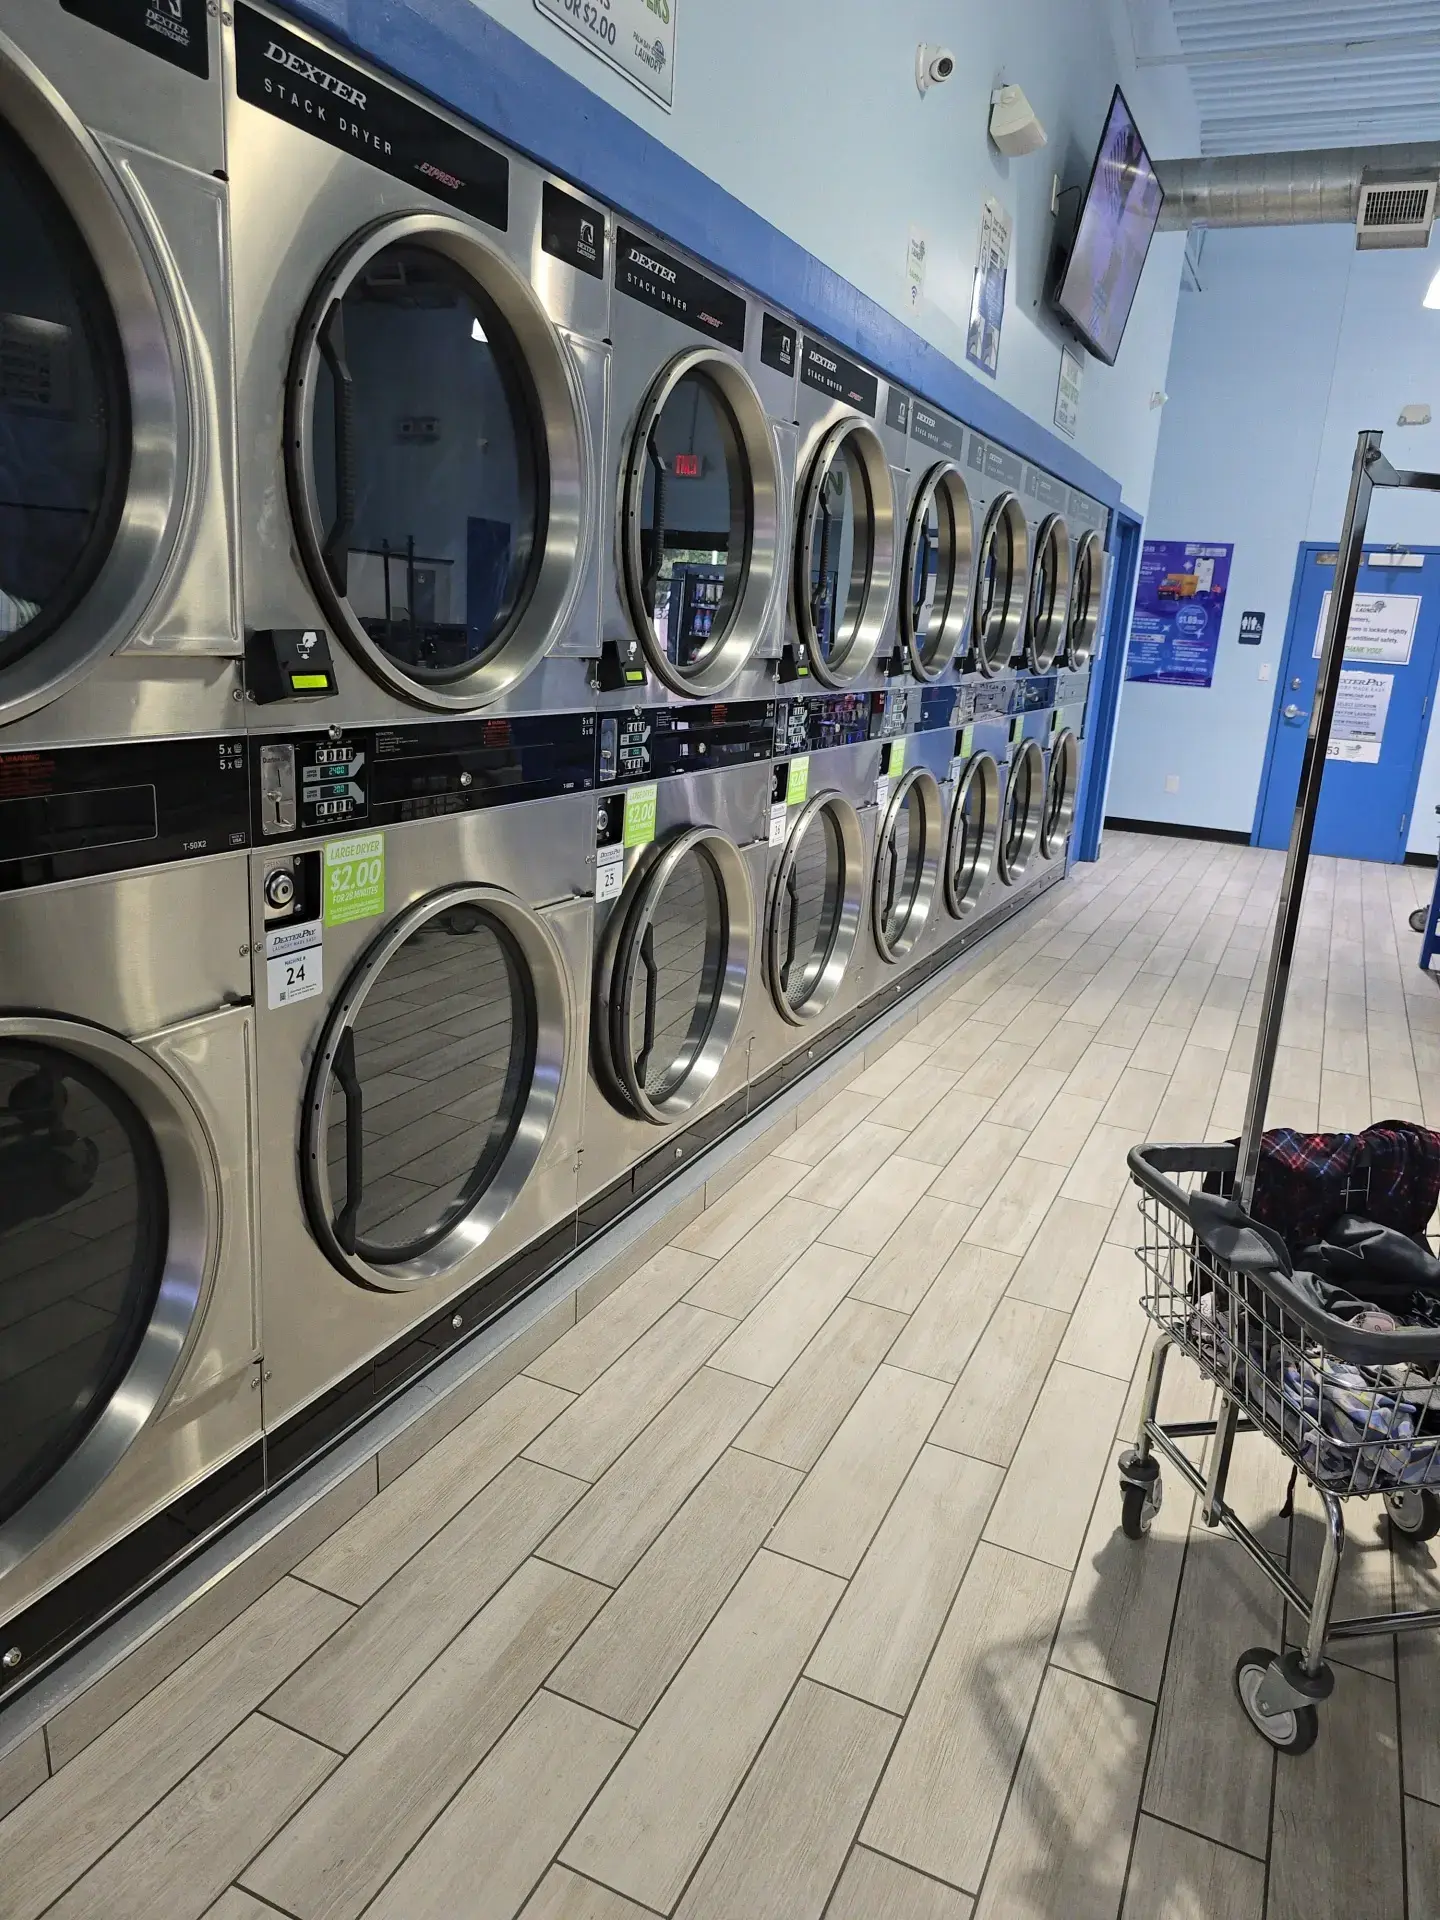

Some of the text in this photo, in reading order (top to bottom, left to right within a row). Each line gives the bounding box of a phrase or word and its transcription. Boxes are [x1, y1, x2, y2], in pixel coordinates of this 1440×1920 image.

[145, 9, 189, 38] DEXTER
[145, 19, 190, 46] LAUNDRY
[583, 2, 616, 46] $2.00
[635, 44, 662, 74] LAUNDRY
[263, 41, 367, 110] DEXTER
[264, 78, 392, 155] STACK DRYER
[420, 162, 461, 189] EXPRESS
[629, 248, 676, 284] DEXTER
[627, 273, 687, 311] STACK DRYER
[809, 351, 837, 373] DEXTER
[807, 368, 825, 383] STACK
[916, 412, 936, 427] DEXTER
[1389, 628, 1408, 636] nightly
[219, 744, 226, 755] 5
[219, 760, 226, 770] 5
[329, 766, 345, 775] 2400
[333, 784, 345, 793] 200
[628, 802, 654, 825] $2.00
[183, 840, 207, 850] T-50X2
[330, 841, 379, 860] LARGE DRYER
[331, 859, 381, 893] $2.00
[605, 873, 615, 887] 25
[354, 885, 379, 899] MINUTES
[286, 964, 305, 986] 24
